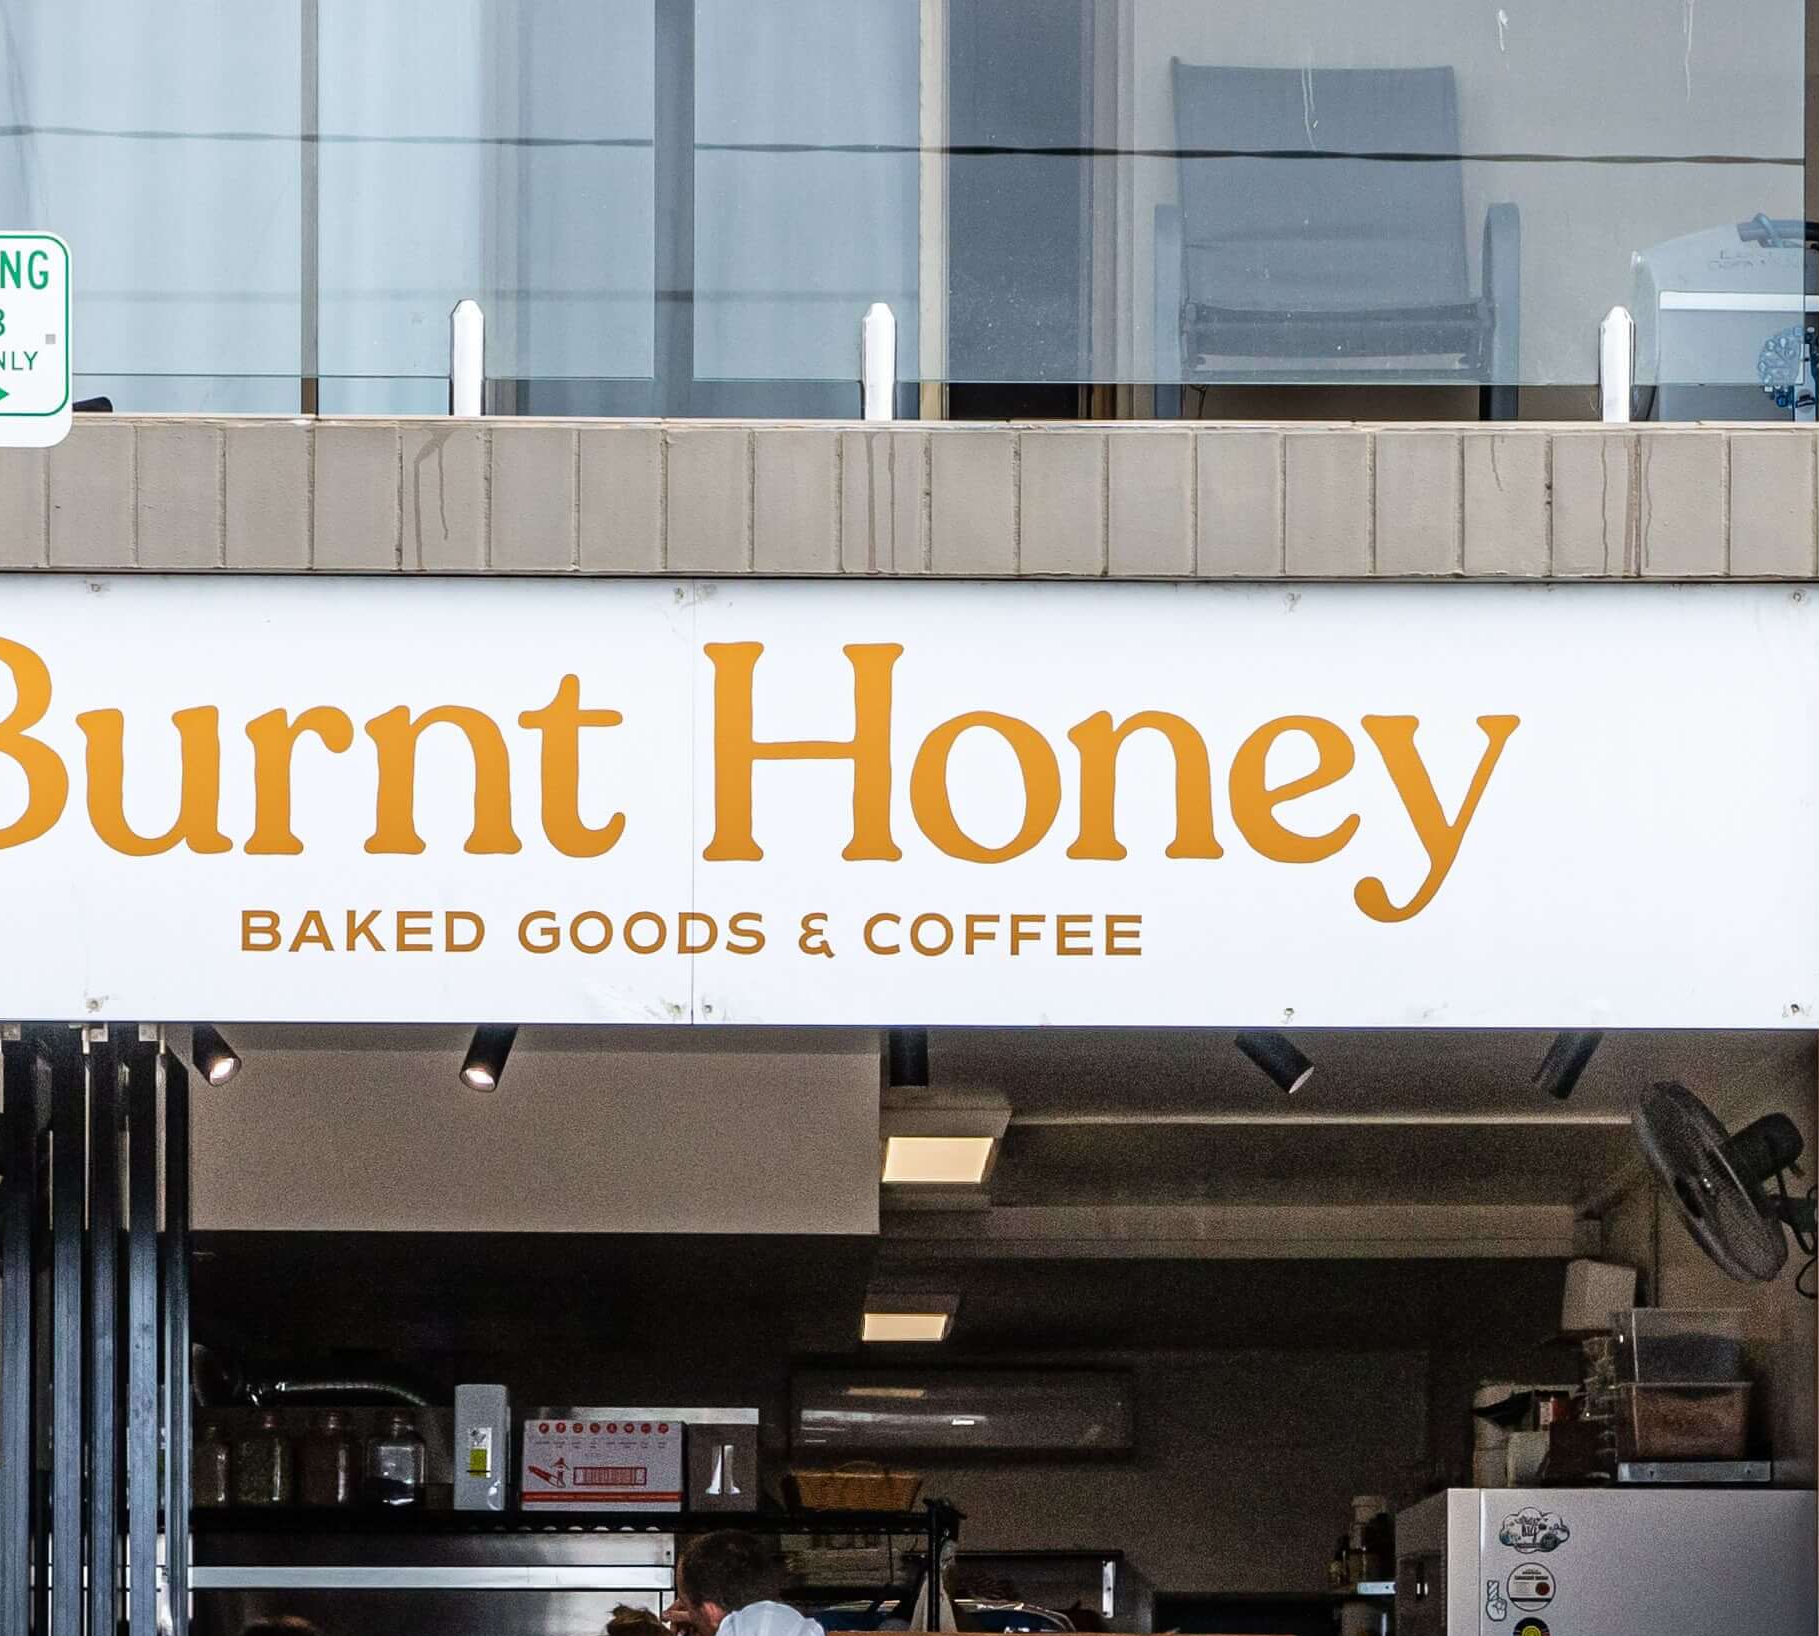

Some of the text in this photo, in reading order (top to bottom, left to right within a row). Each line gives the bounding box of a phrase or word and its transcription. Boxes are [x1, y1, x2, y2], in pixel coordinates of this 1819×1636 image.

[703, 642, 1520, 923] Honey
[242, 910, 1142, 957] BAKED GOODS & COFFEE
